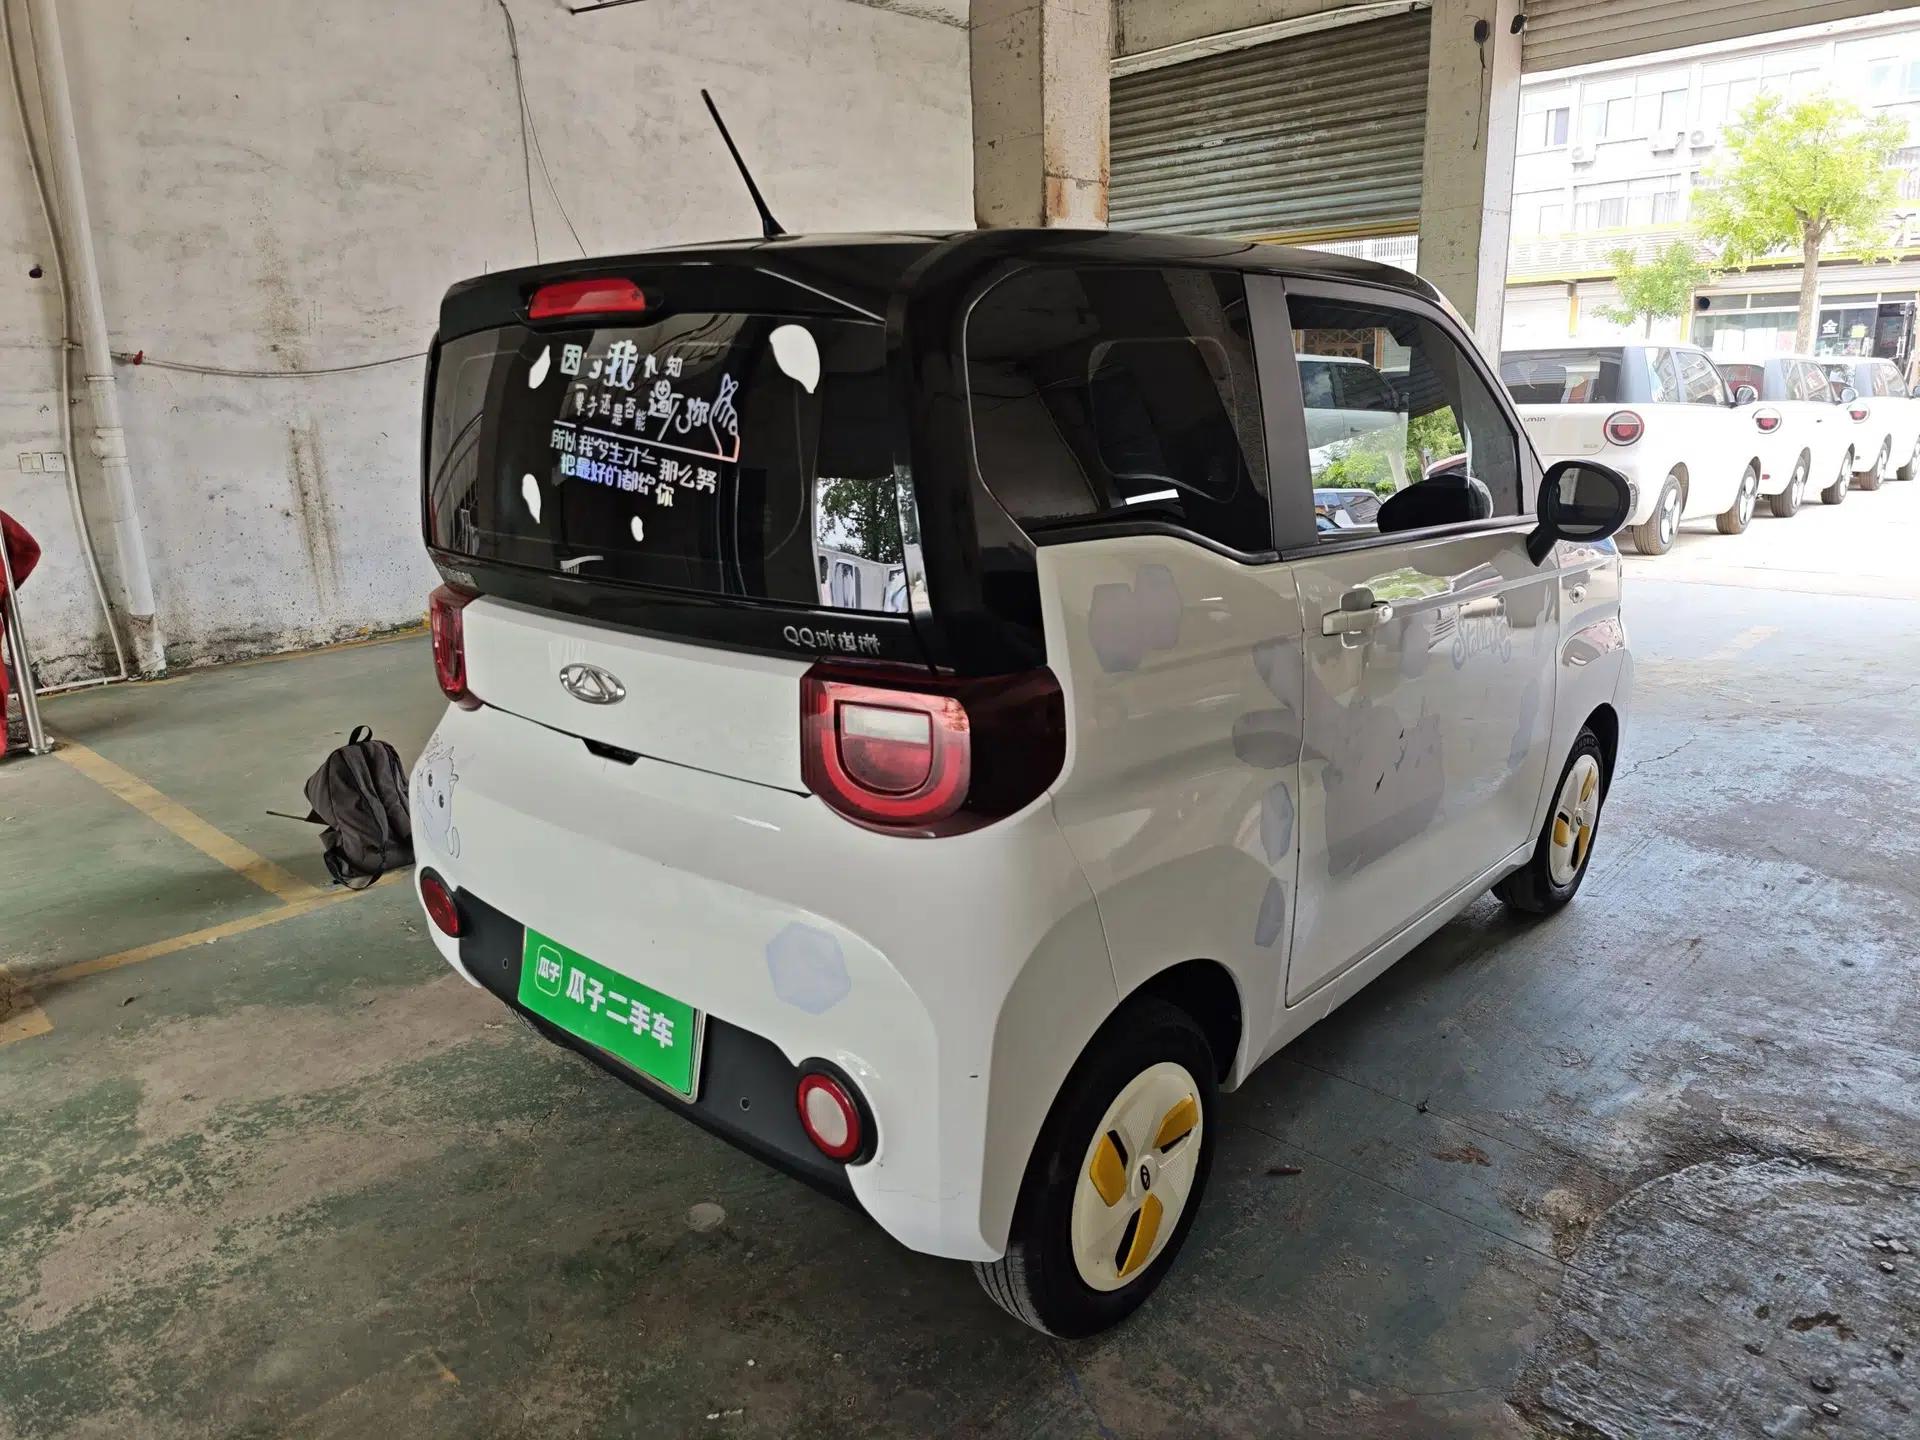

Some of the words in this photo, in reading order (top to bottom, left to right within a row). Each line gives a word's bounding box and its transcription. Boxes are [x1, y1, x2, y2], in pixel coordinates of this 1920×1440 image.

[538, 956, 560, 983] 瓜子
[566, 967, 674, 1048] 瓜子二手车
